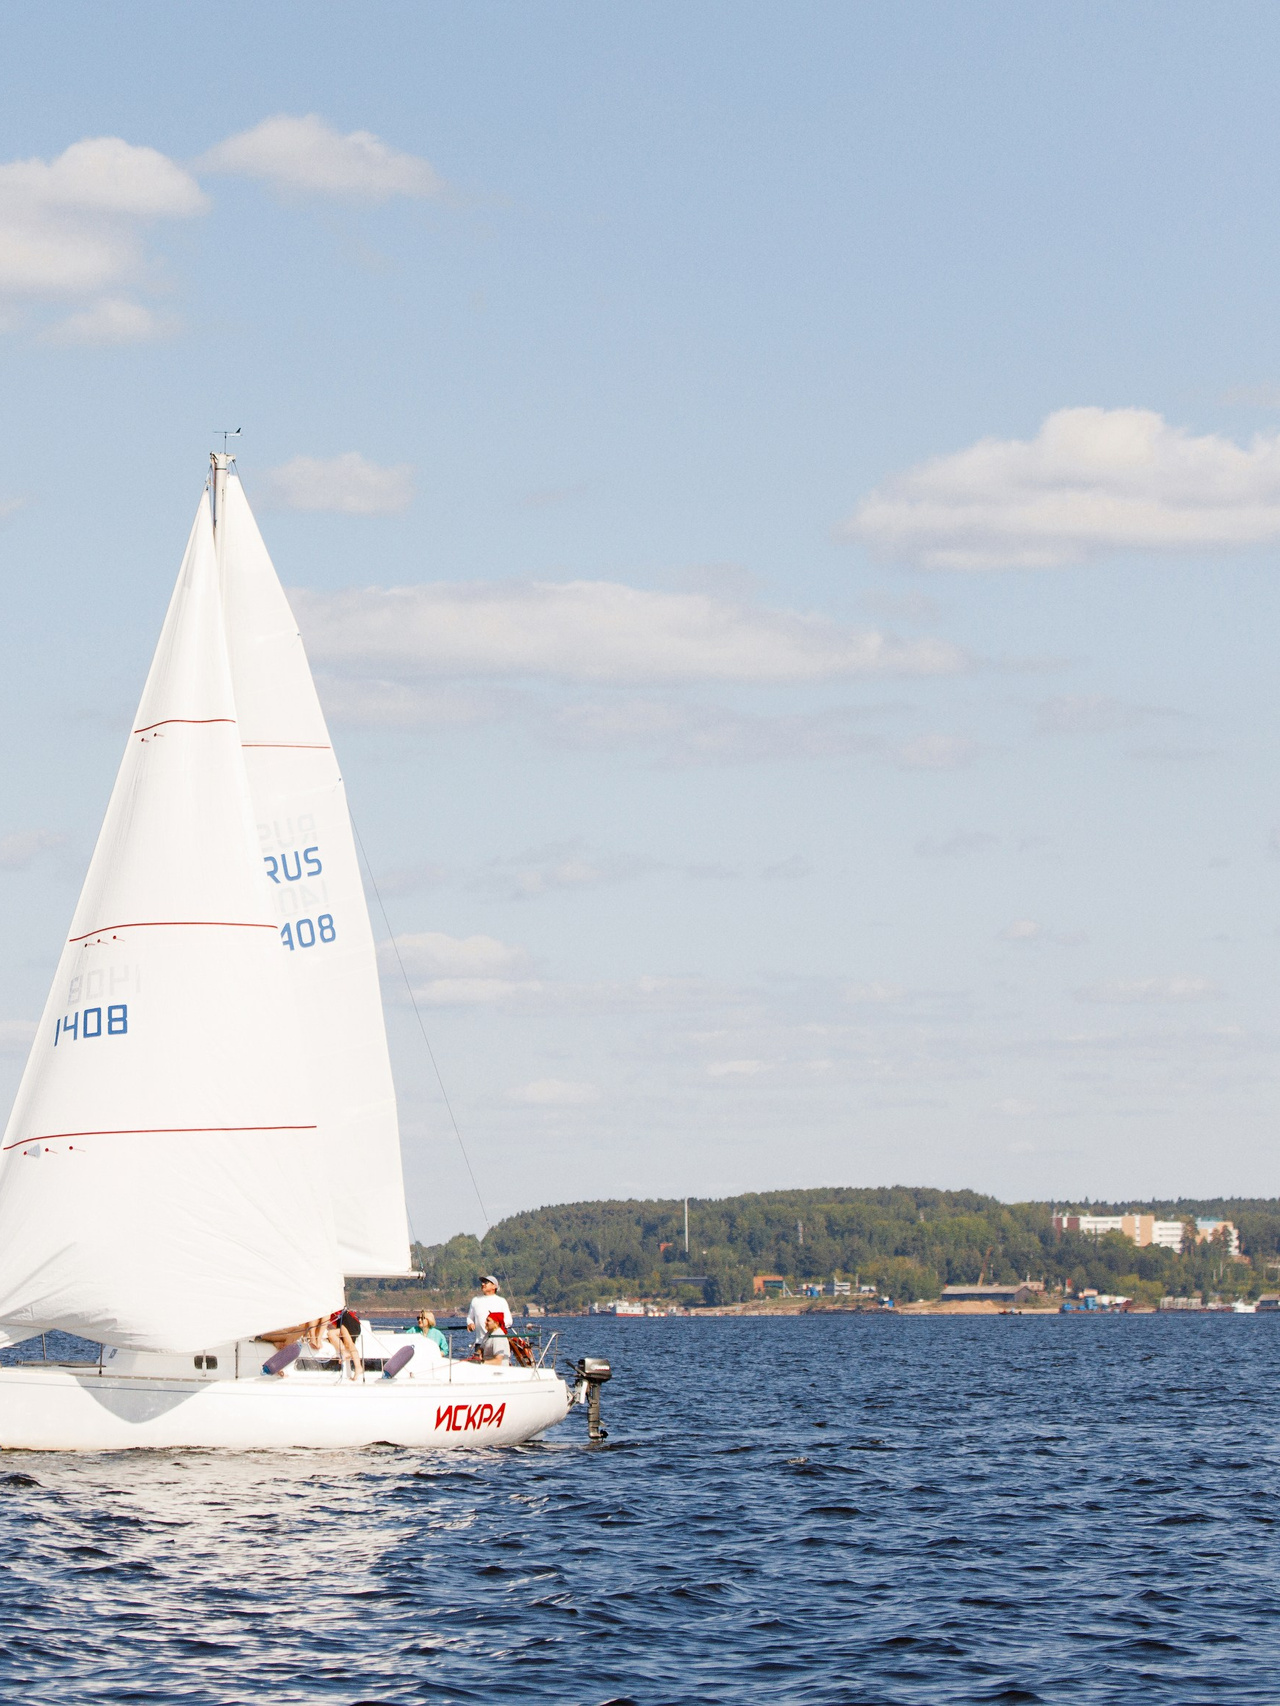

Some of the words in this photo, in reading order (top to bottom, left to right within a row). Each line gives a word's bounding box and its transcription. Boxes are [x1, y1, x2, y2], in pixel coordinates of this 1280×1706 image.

[263, 846, 322, 884] RUS
[54, 1004, 128, 1047] 1408
[434, 1402, 506, 1432] ИСКРА
